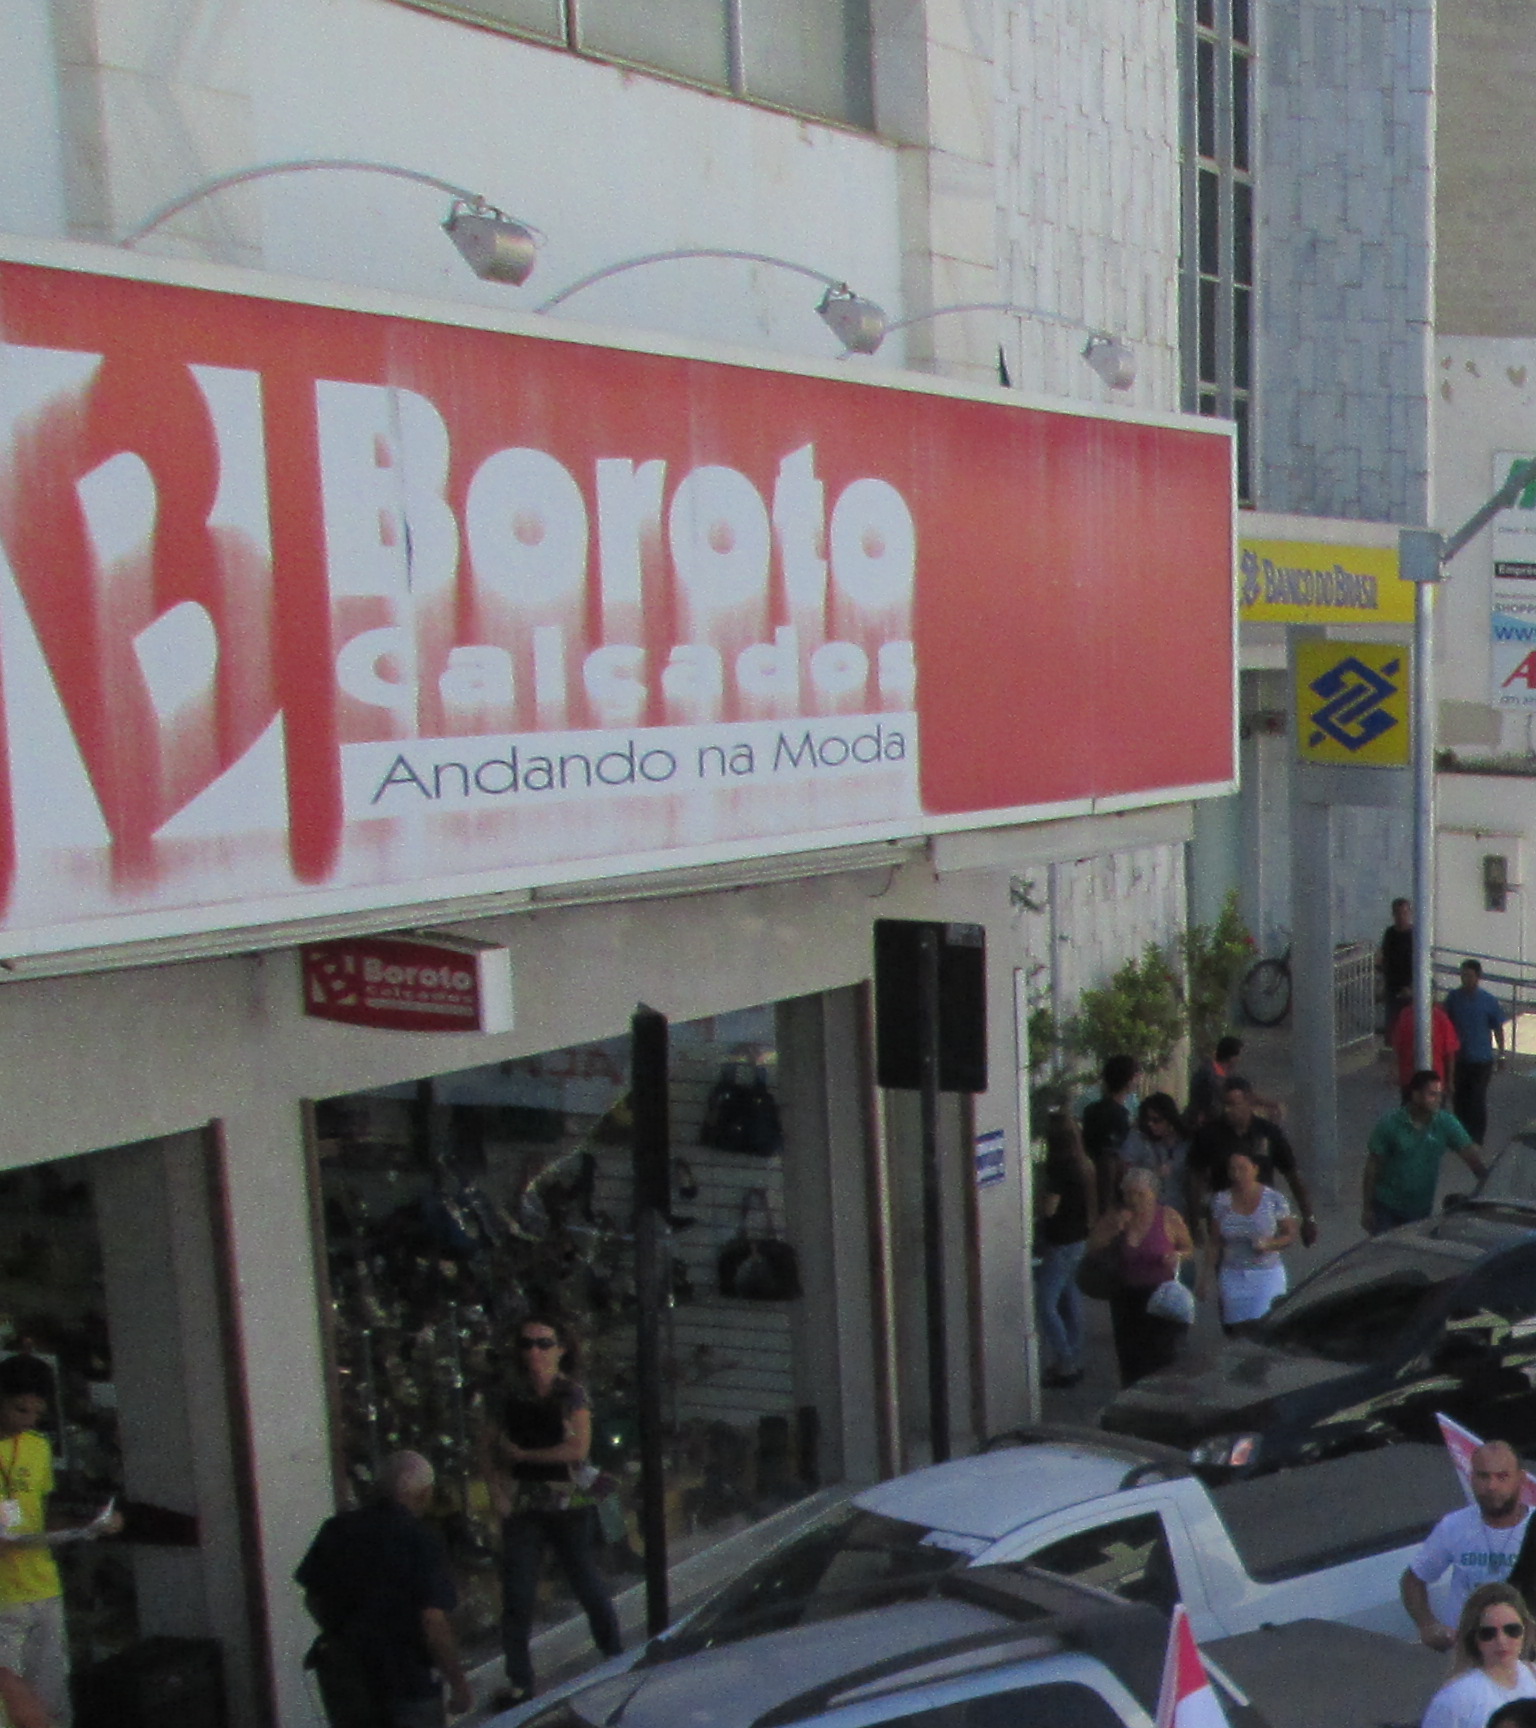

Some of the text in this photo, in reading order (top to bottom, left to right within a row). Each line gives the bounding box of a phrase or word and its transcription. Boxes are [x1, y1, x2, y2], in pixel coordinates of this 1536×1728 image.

[372, 723, 906, 803] Andando na Moda
